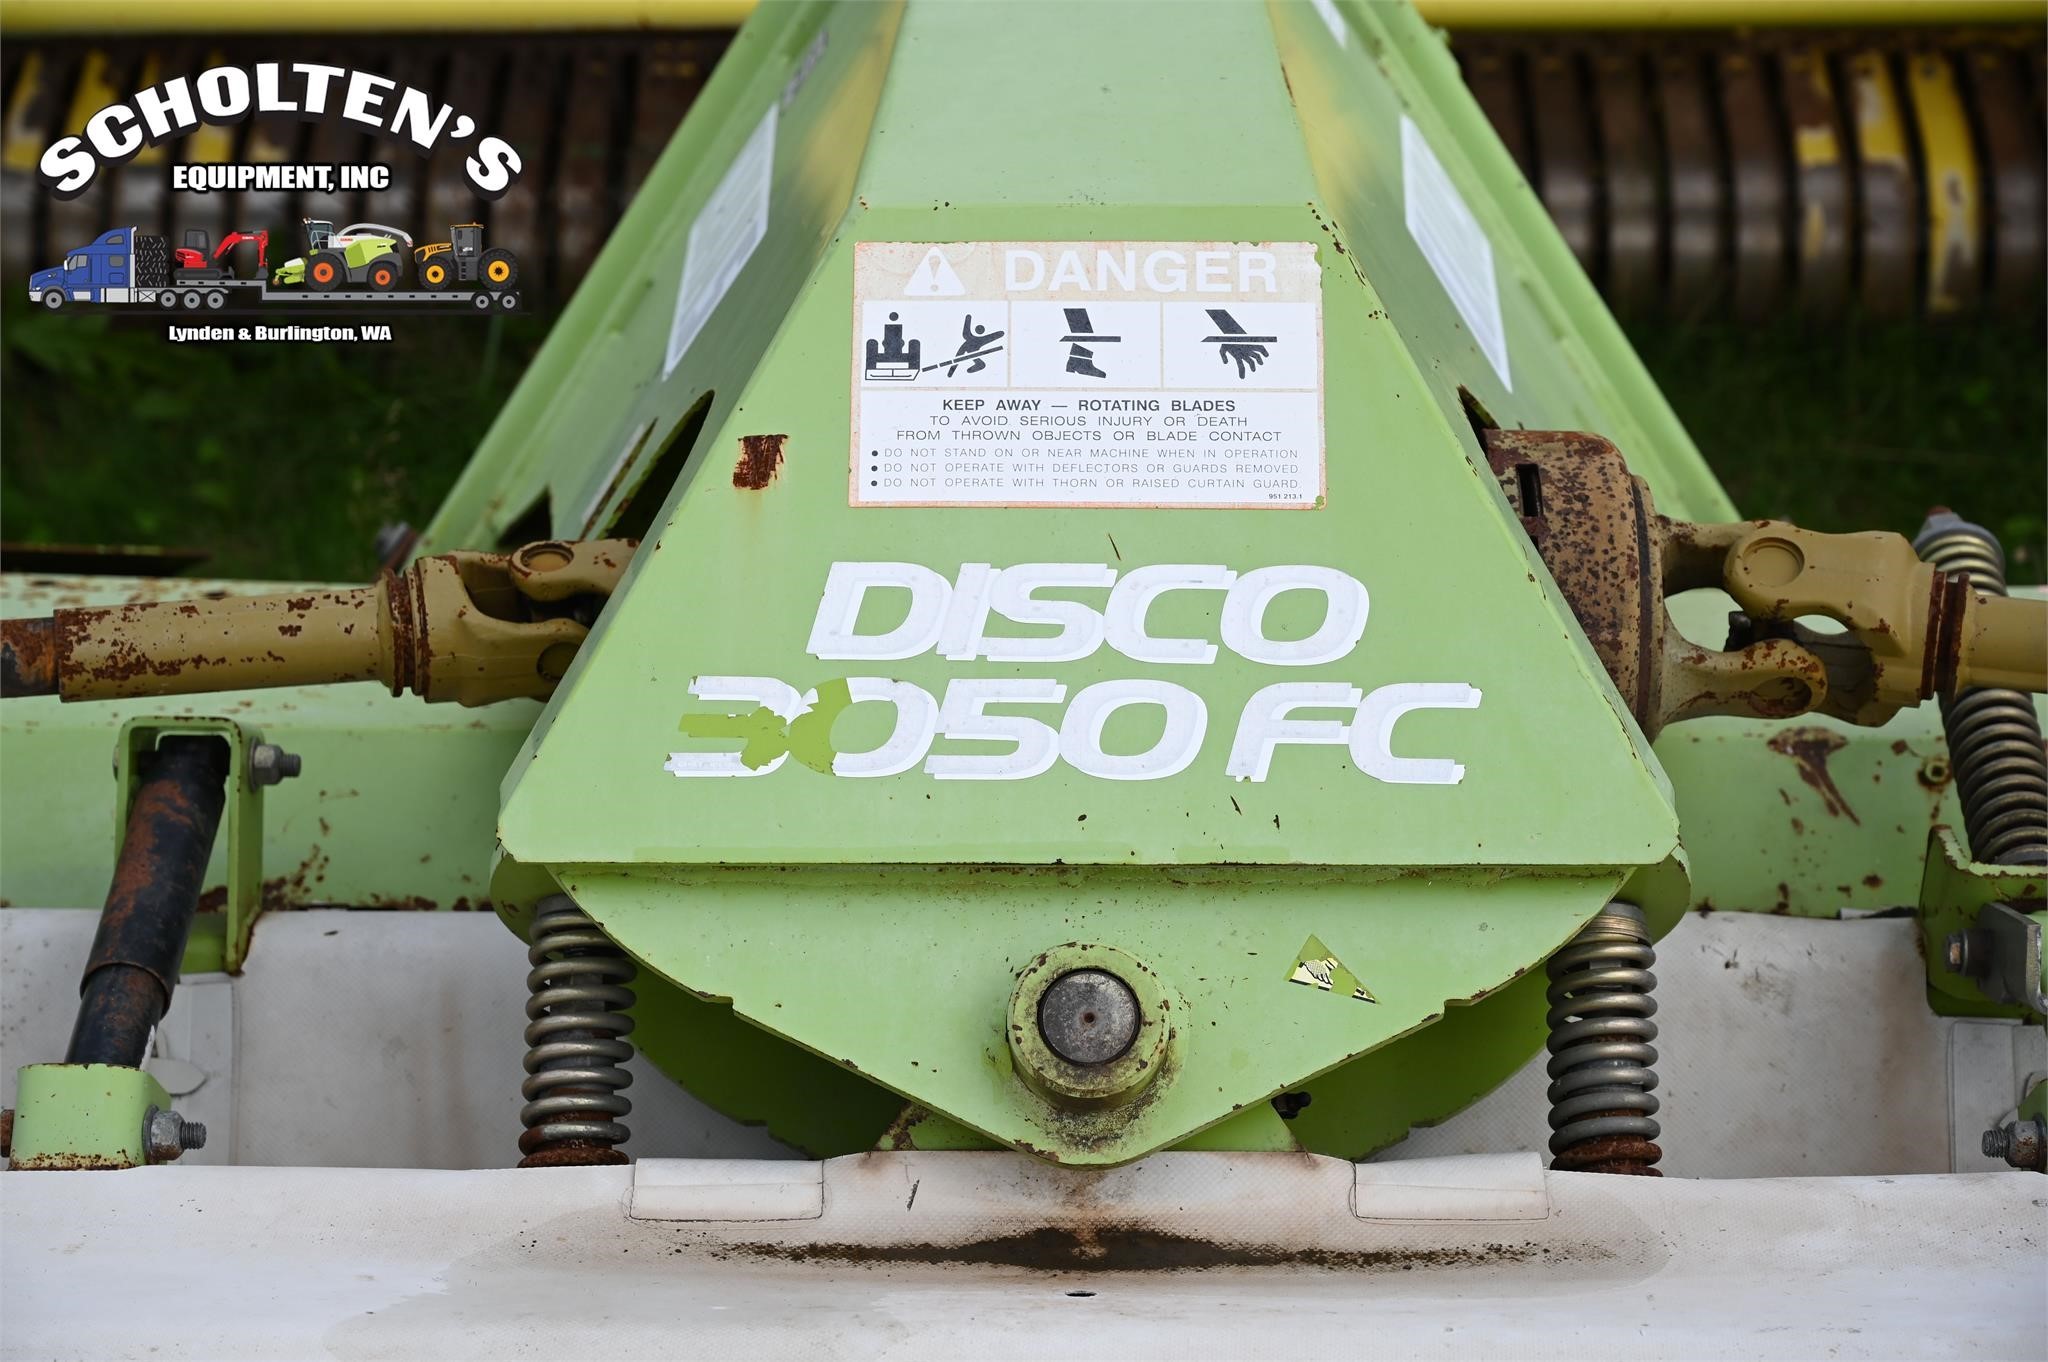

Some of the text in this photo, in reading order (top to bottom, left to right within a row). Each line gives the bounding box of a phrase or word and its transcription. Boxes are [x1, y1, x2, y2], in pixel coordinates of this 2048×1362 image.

[1004, 249, 1278, 294] DANGER
[942, 399, 985, 411] KEEP
[995, 399, 1042, 411] AWAY
[1078, 399, 1160, 412] ROTATING
[1171, 399, 1236, 412] BLADES
[929, 415, 1248, 427] TO AVOID SERIOUS INJURY OR DEATH
[897, 430, 1282, 442] FROM THROWN OBJECTS OR BLADE CONTACT
[884, 447, 1298, 459] DO NOT STAND ON OR NEAR MACHINE WHEN IN OPERATION
[884, 462, 1299, 474] DO NOT OPERATE WITH DEFLECTORS OR GUARDS REMOVED
[883, 478, 903, 488] DO
[910, 477, 936, 488] NOT
[944, 477, 1003, 488] OPERATE
[1012, 477, 1044, 487] WITH
[1052, 478, 1097, 488] THORN
[1105, 478, 1124, 488] OR
[1132, 478, 1180, 488] RAISED
[1187, 478, 1245, 489] CURTAIN
[806, 561, 1369, 666] DISCO
[663, 675, 1483, 784] 3050 FC
